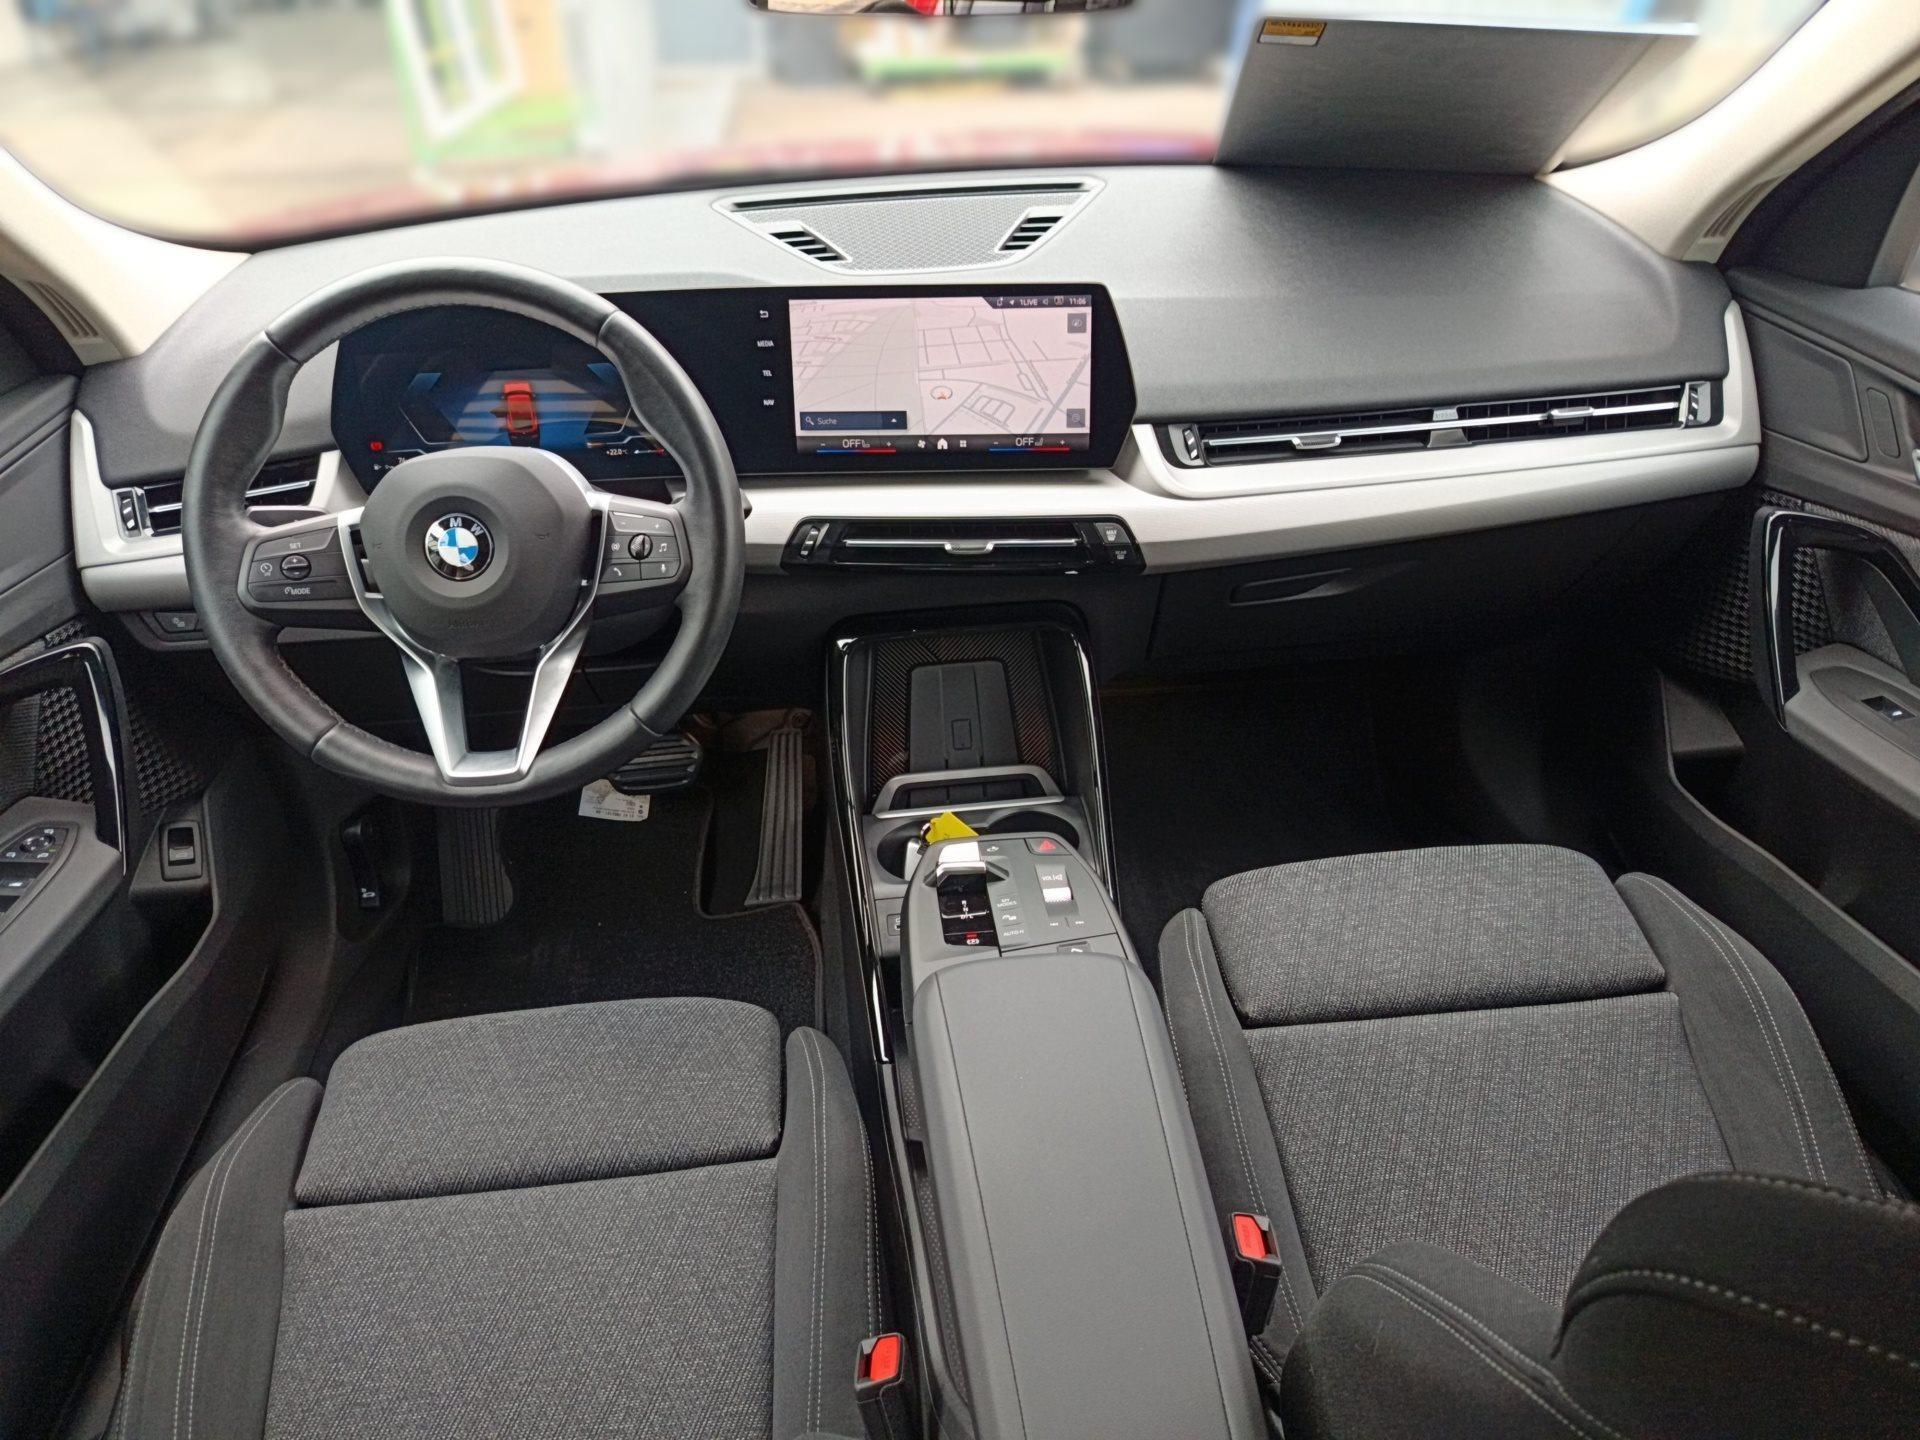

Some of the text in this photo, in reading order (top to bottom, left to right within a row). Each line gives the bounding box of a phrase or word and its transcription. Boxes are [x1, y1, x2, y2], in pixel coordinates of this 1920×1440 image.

[817, 417, 837, 425] Suche
[842, 439, 861, 448] OFF
[1015, 438, 1034, 447] OFF
[292, 587, 311, 595] MODE
